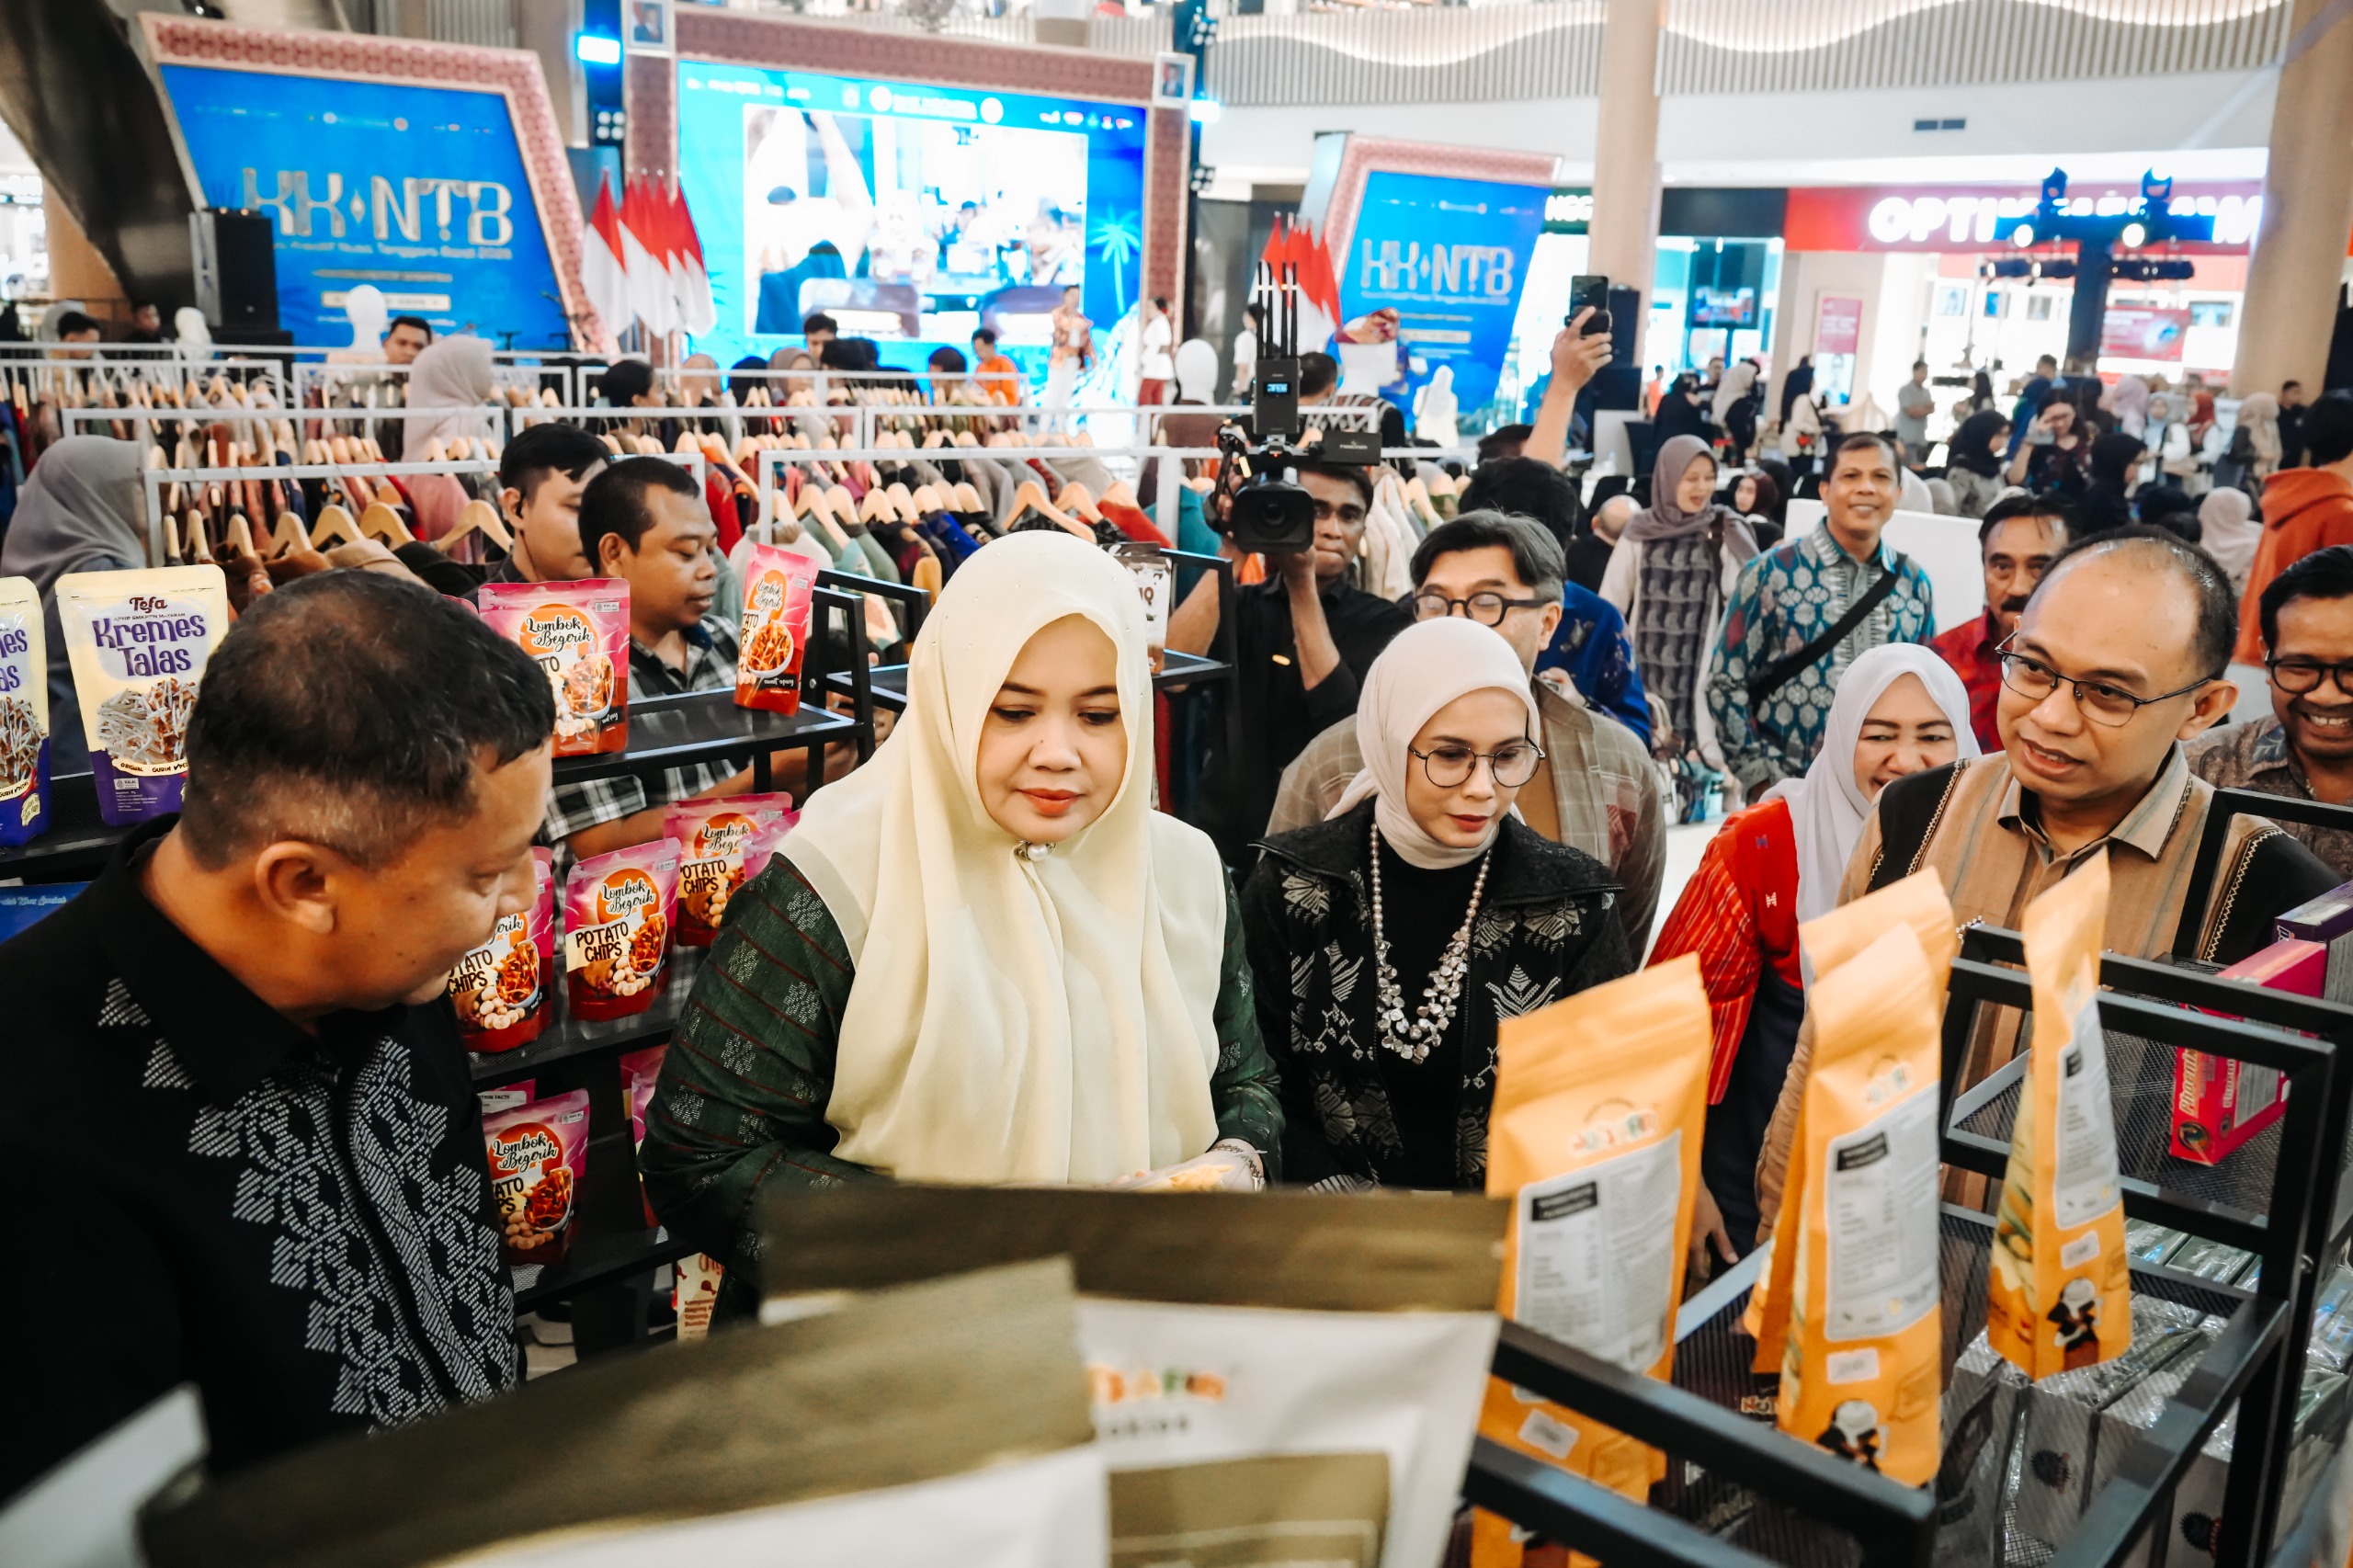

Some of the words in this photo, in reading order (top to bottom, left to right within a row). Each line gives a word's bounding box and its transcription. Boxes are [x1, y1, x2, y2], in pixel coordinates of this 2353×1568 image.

[130, 597, 168, 613] Tefa
[92, 615, 206, 648] Kremes
[527, 616, 581, 633] Lombok
[534, 628, 591, 652] Begerik
[117, 645, 191, 676] Talas
[702, 824, 749, 840] Lombok
[706, 837, 741, 856] Bege
[601, 880, 645, 900] Lombok
[684, 877, 719, 894] CHIPS
[608, 889, 654, 917] Begerik
[575, 921, 630, 948] POTATO
[585, 942, 622, 962] CHIPS
[447, 971, 488, 995] CHIPS
[494, 1132, 547, 1156] Lombok
[499, 1142, 557, 1173] Begerik
